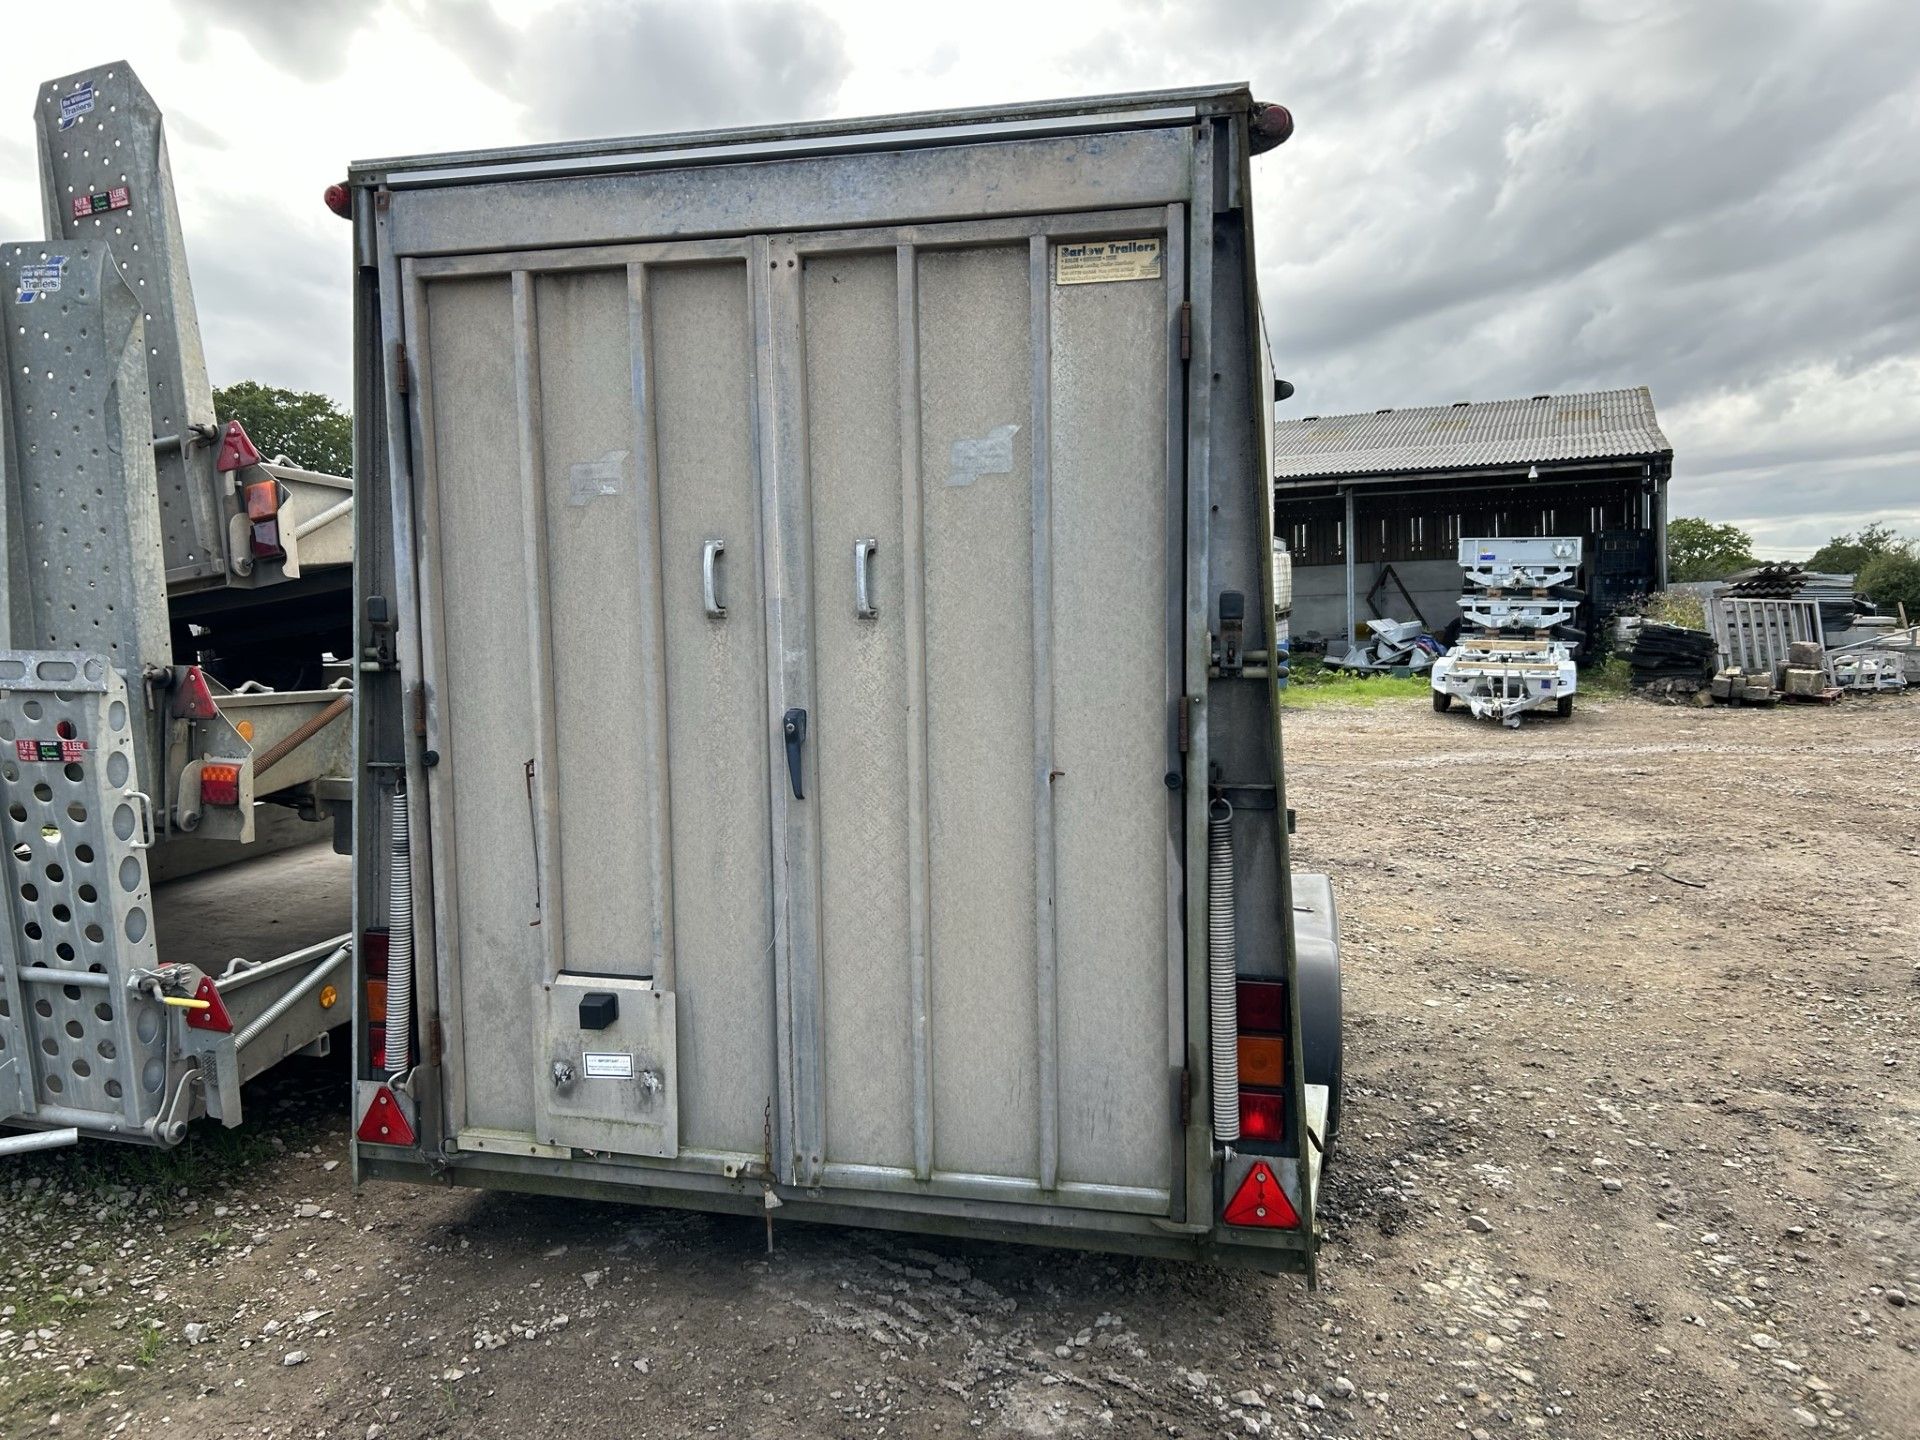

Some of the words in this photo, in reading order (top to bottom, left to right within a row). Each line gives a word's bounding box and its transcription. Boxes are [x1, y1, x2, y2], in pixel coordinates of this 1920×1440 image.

[64, 102, 92, 115] Trailers
[1061, 246, 1105, 257] Barlow
[1108, 242, 1156, 254] Trailers
[68, 742, 84, 751] LEEK
